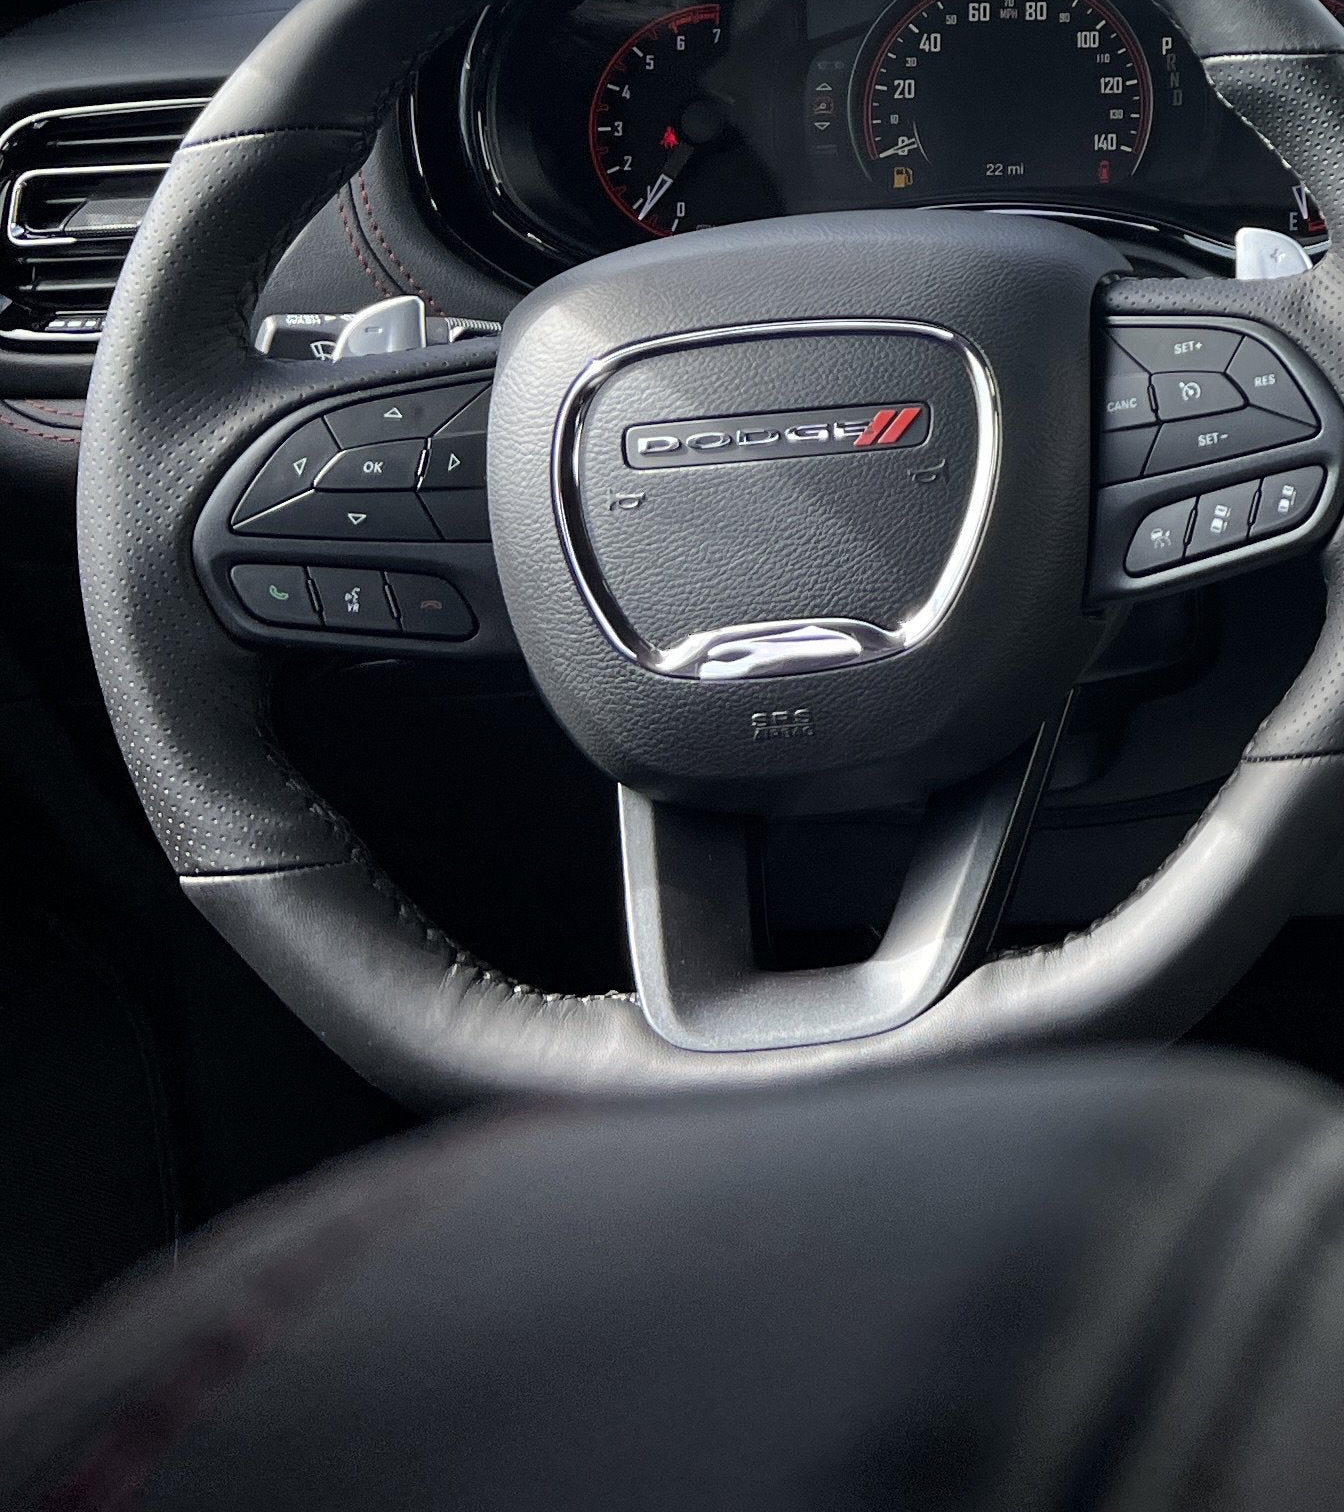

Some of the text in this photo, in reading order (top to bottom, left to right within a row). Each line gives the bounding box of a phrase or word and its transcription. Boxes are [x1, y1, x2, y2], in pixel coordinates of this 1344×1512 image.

[968, 3, 990, 21] 60
[1000, 9, 1018, 19] MPH
[1025, 2, 1047, 20] 80
[676, 36, 686, 50] 6
[712, 29, 721, 43] 7
[920, 33, 941, 52] 40
[1077, 31, 1099, 48] 100
[1162, 37, 1172, 55] P
[646, 55, 654, 70] 5
[622, 85, 630, 99] 4
[894, 80, 915, 99] 20
[1100, 77, 1123, 93] 120
[614, 121, 623, 136] 3
[1094, 134, 1117, 151] 140
[623, 156, 632, 170] 2
[986, 163, 1024, 175] 22 mi
[1289, 212, 1298, 231] E
[1254, 374, 1276, 387] RES
[1107, 398, 1137, 412] CANC
[638, 420, 873, 455] DODGE
[363, 461, 383, 473] OK
